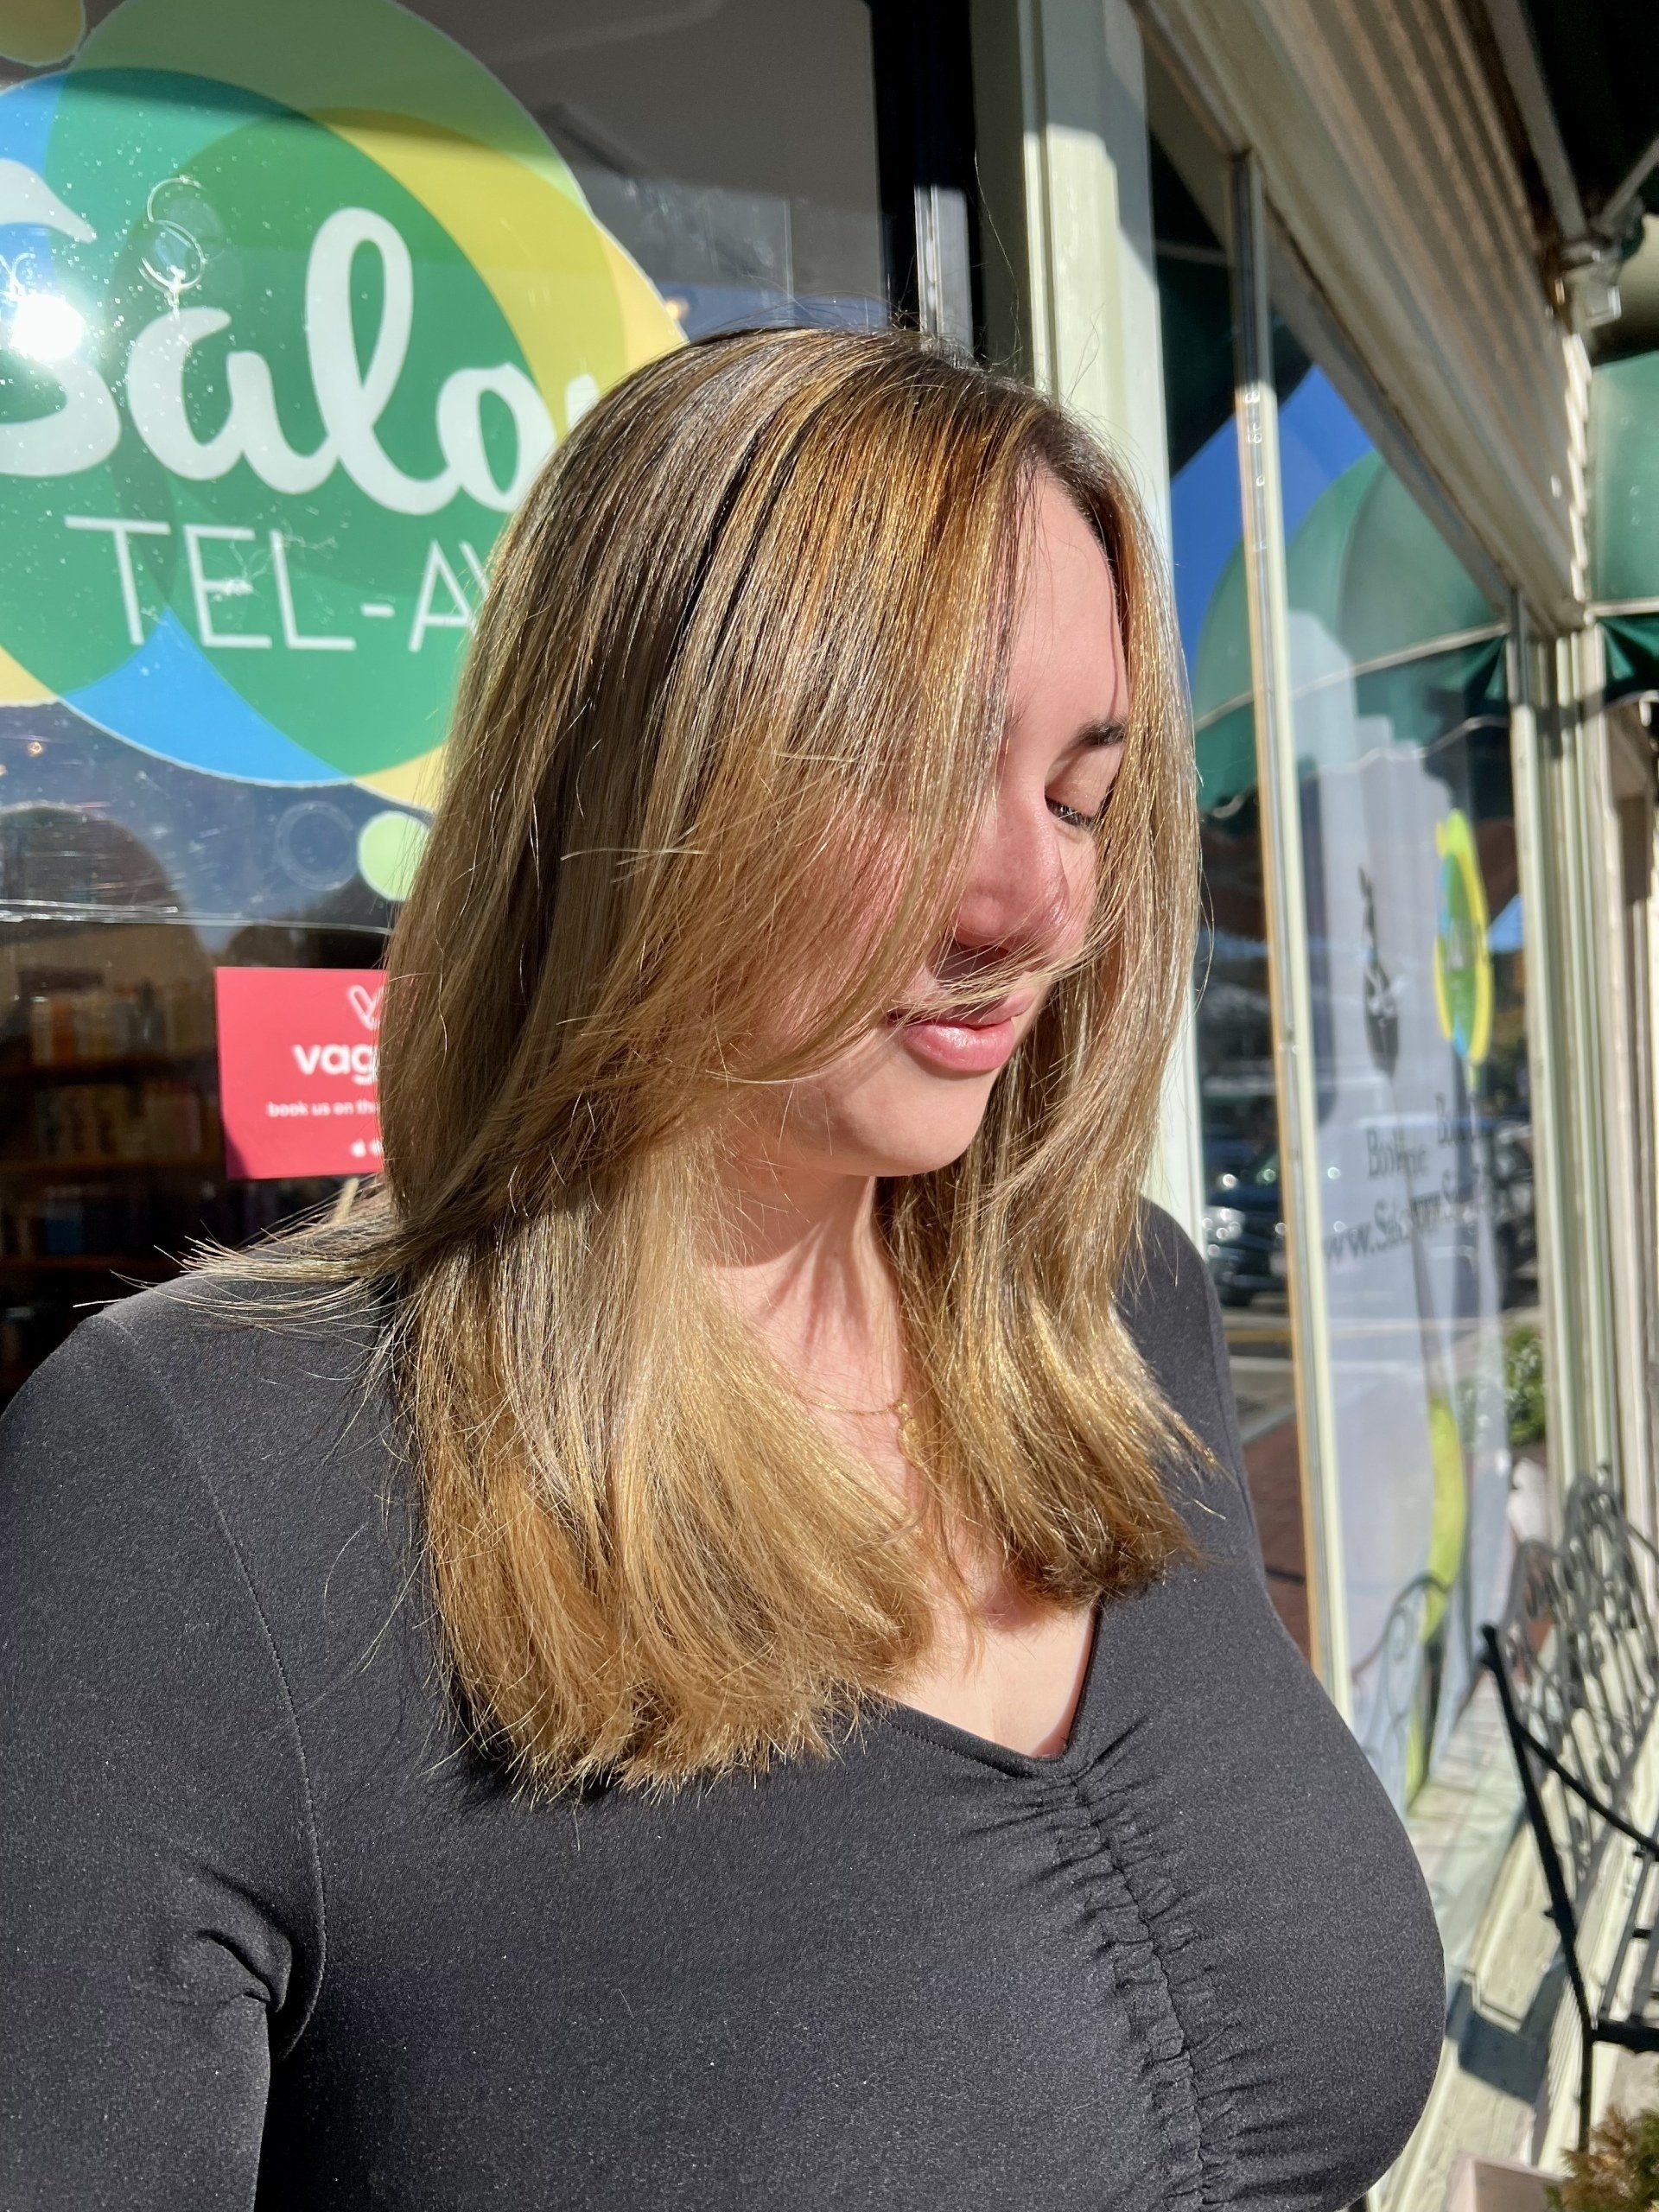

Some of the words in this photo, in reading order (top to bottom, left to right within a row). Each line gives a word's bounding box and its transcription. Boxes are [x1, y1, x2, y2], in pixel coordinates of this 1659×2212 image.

[0, 158, 600, 516] Salo
[267, 1101, 308, 1117] book
[312, 1102, 330, 1116] us
[333, 1102, 353, 1116] on
